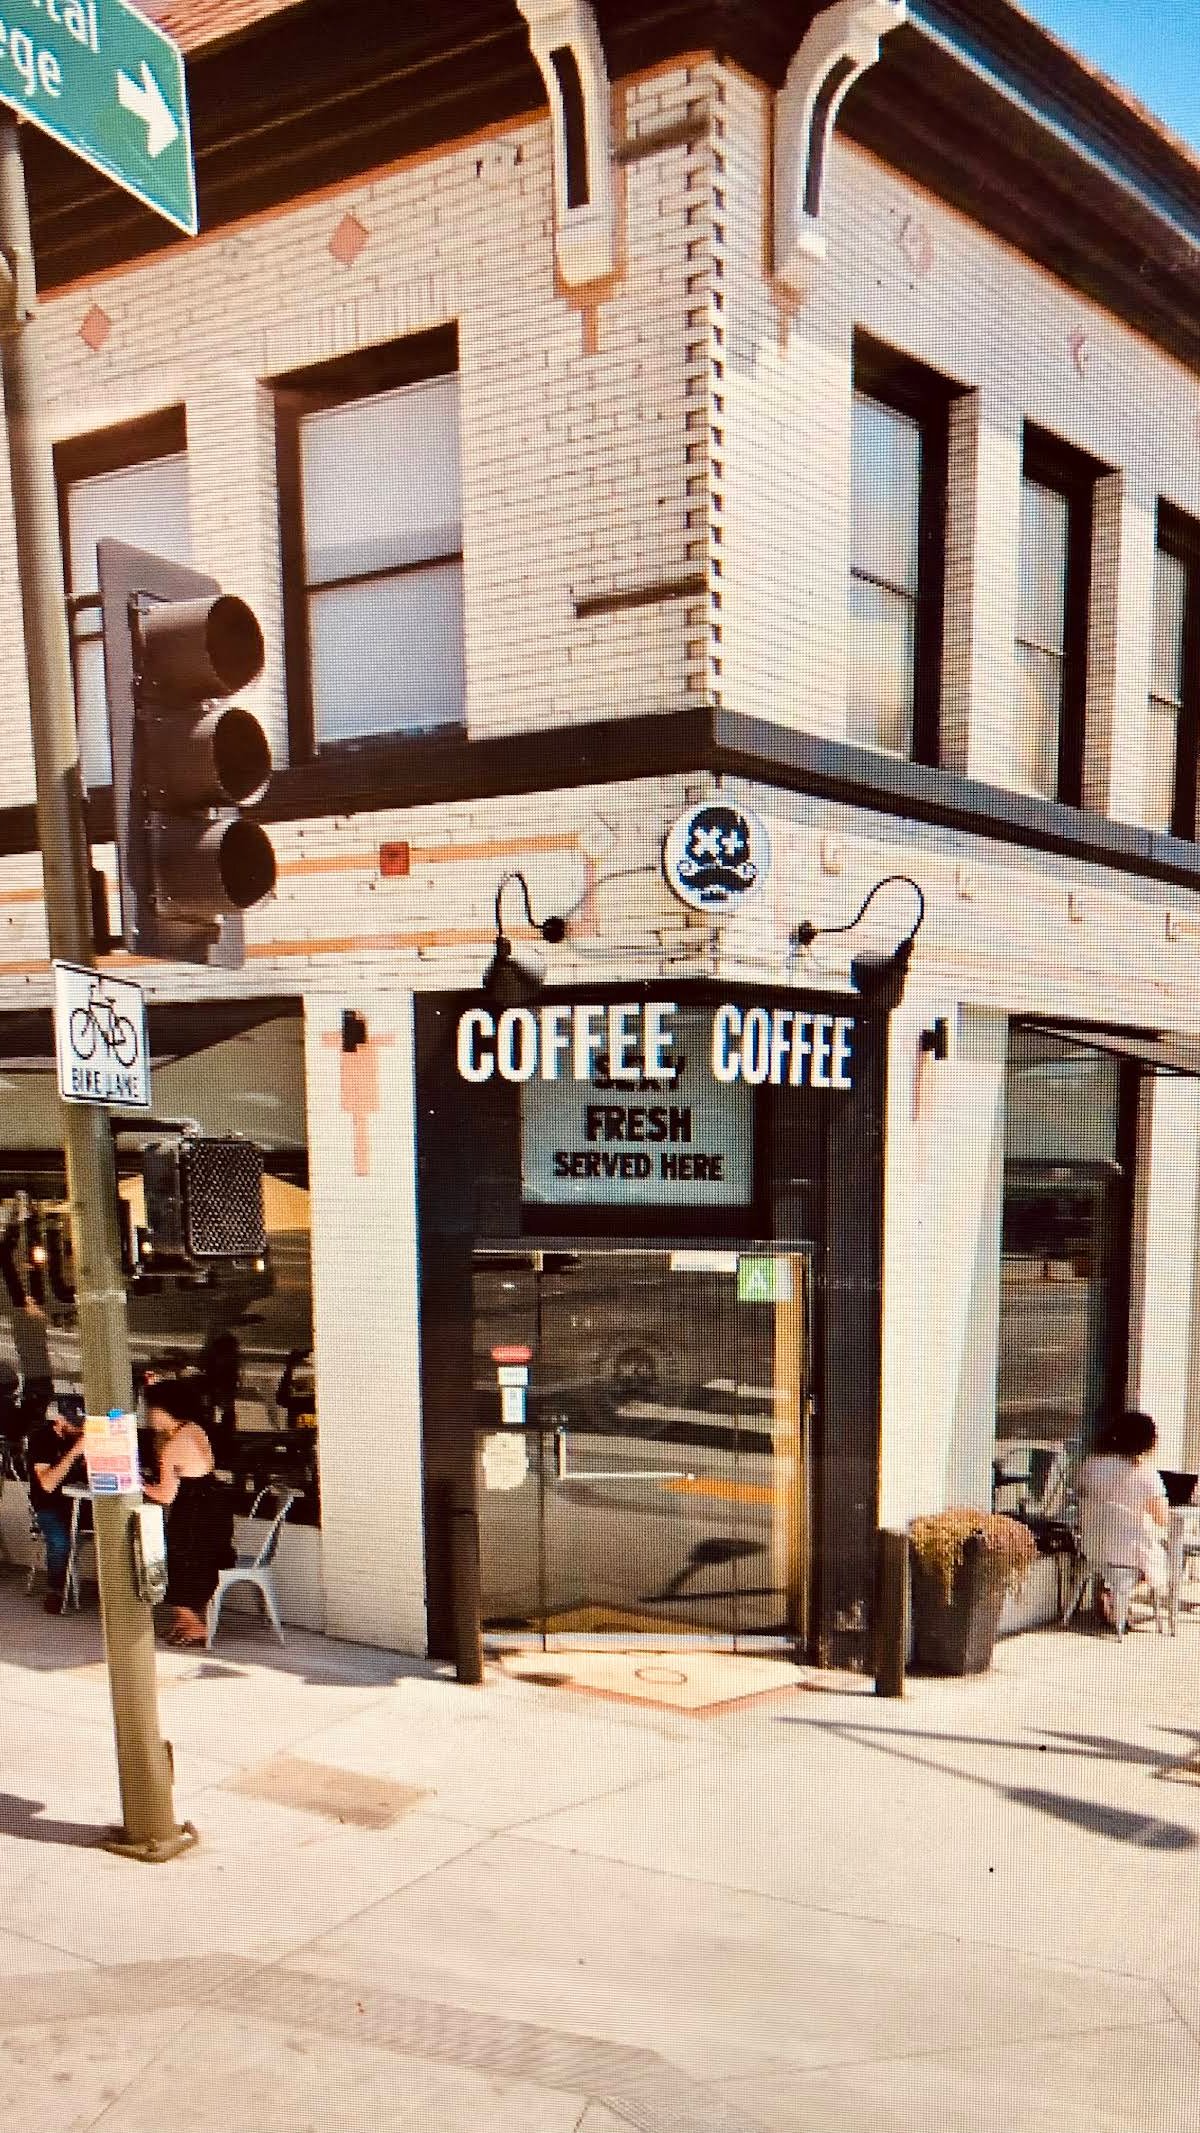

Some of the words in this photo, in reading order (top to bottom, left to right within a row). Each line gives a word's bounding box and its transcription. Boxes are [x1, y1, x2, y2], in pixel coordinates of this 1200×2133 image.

[456, 1002, 678, 1083] COFFEE
[711, 1003, 855, 1089] COFFEE
[72, 1067, 101, 1094] BIKE
[586, 1104, 693, 1142] FRESH
[554, 1151, 652, 1179] SERVED
[660, 1153, 725, 1181] HERE
